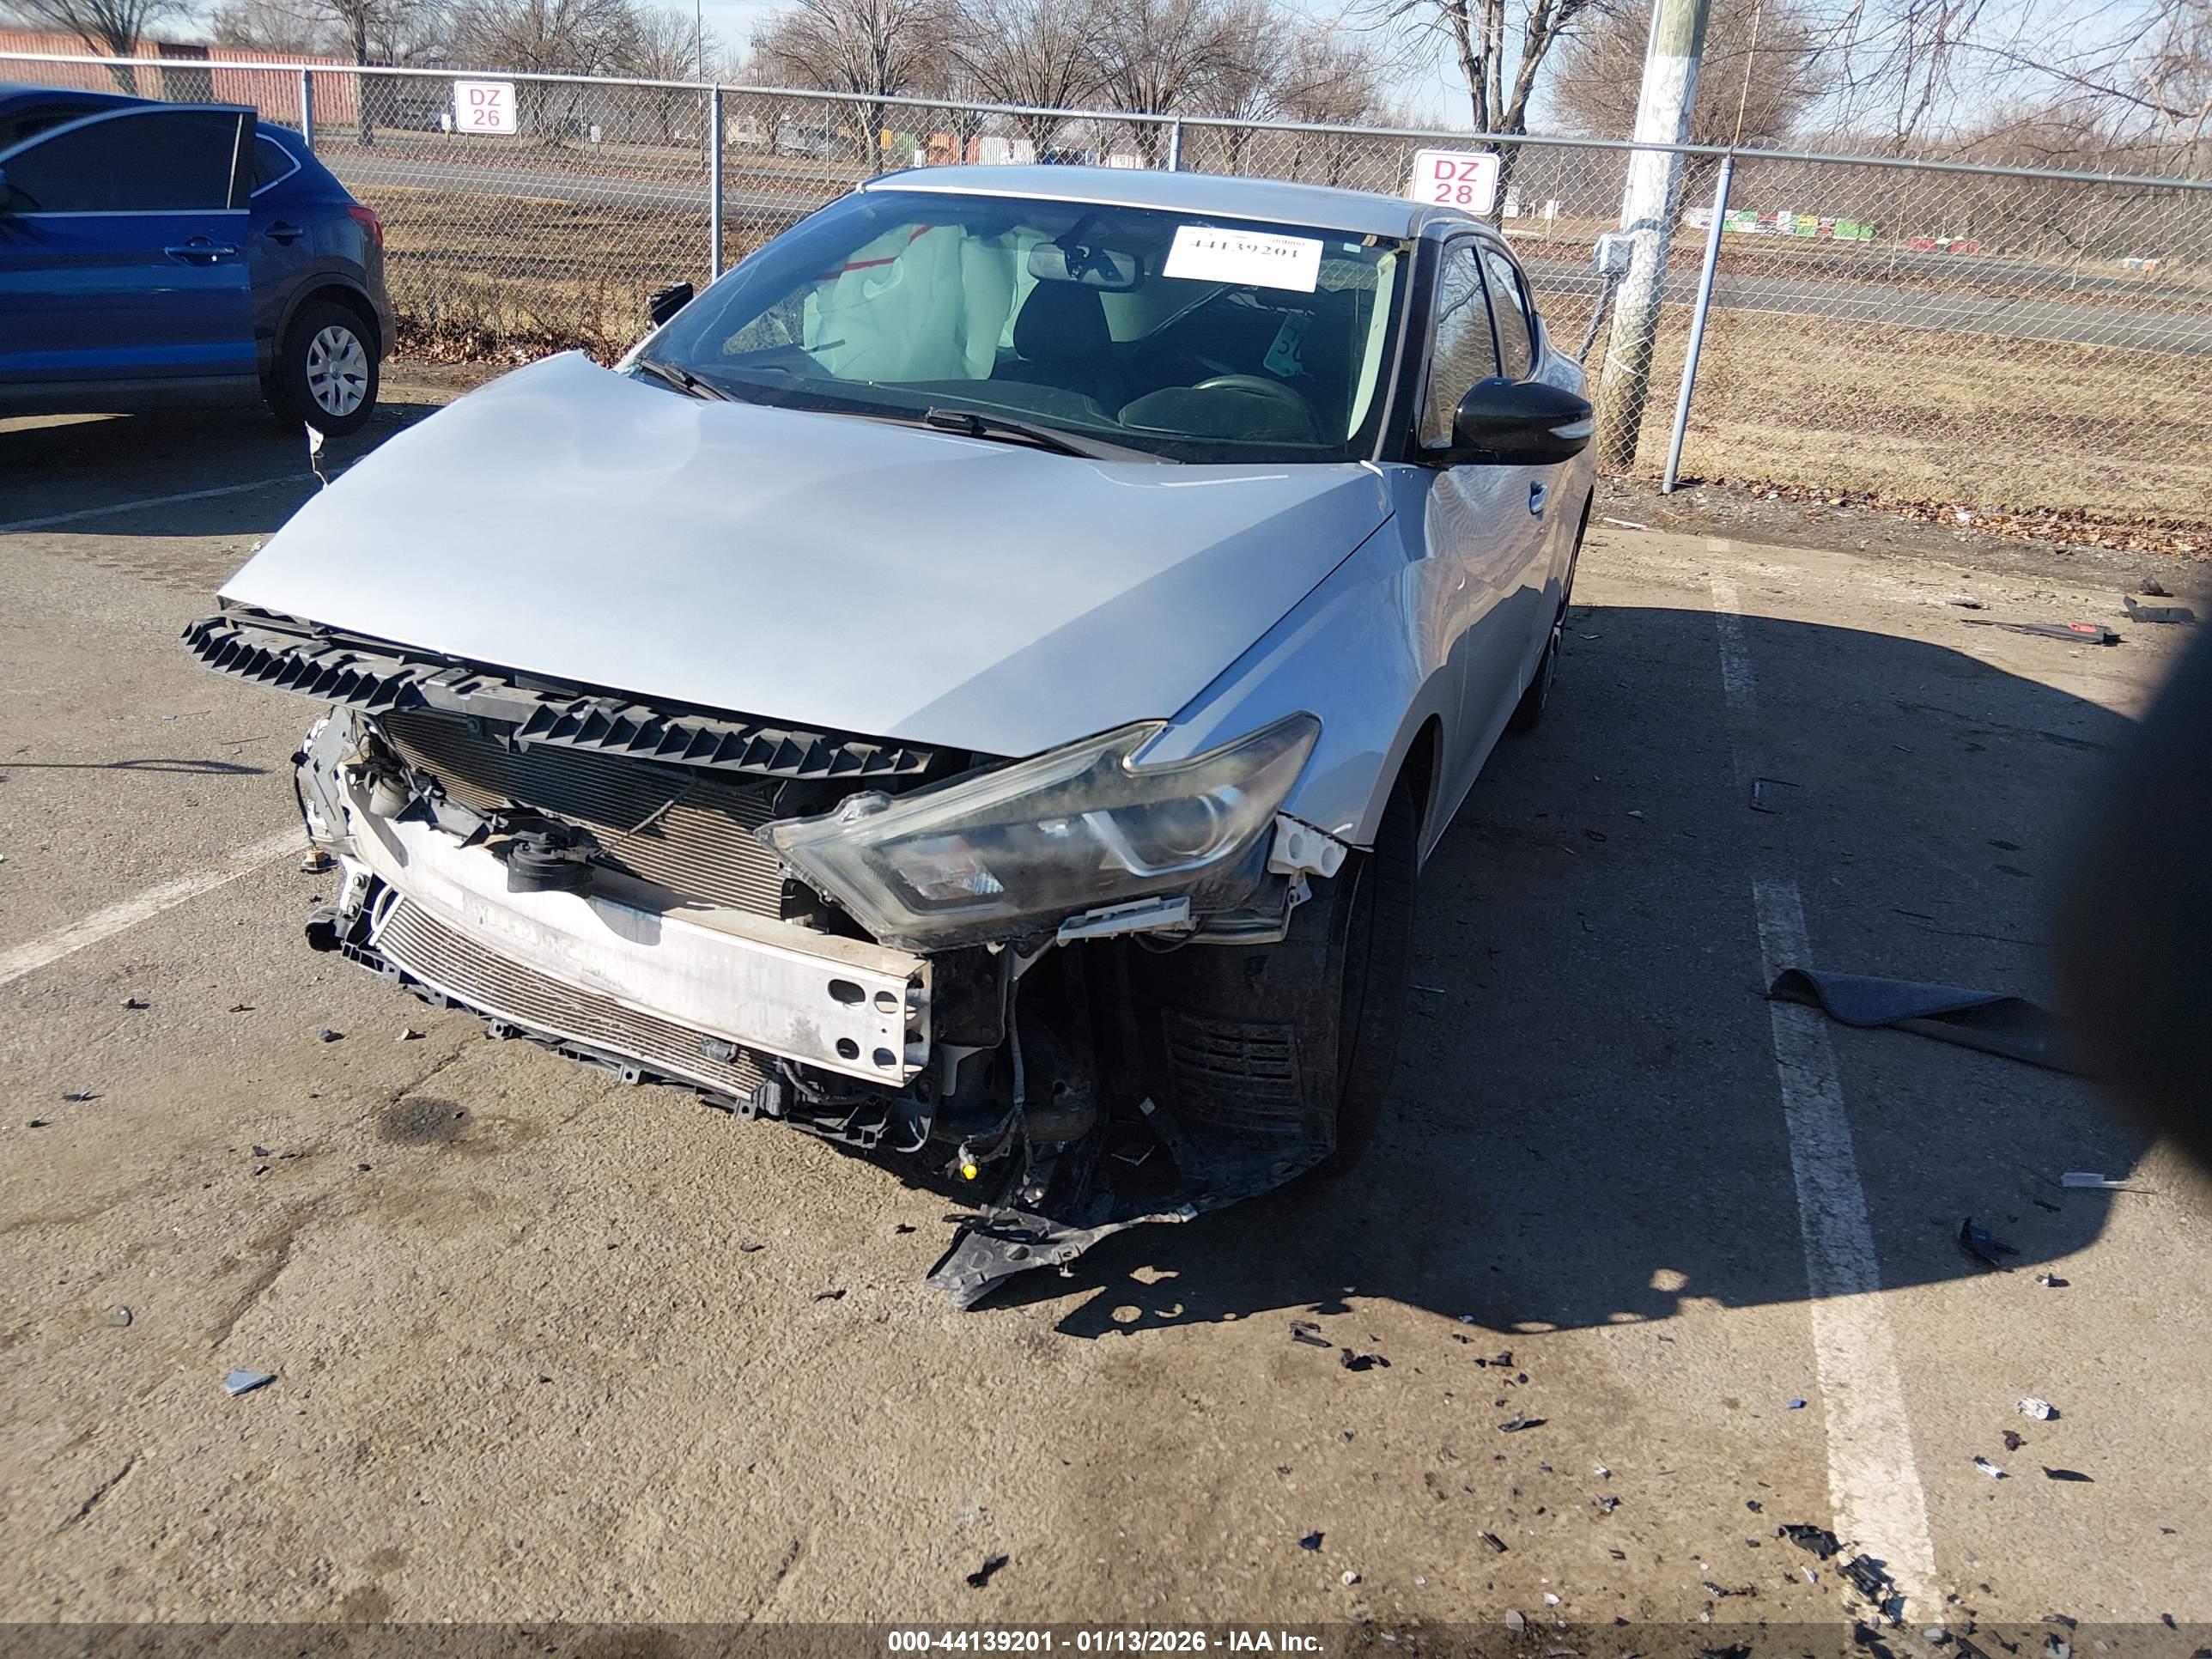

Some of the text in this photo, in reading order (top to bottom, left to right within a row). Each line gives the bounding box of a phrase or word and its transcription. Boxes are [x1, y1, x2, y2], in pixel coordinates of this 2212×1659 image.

[470, 88, 501, 106] DZ
[473, 109, 500, 127] 26
[1434, 160, 1480, 182] DZ
[1434, 183, 1474, 204] 28
[1189, 239, 1298, 258] 44139201
